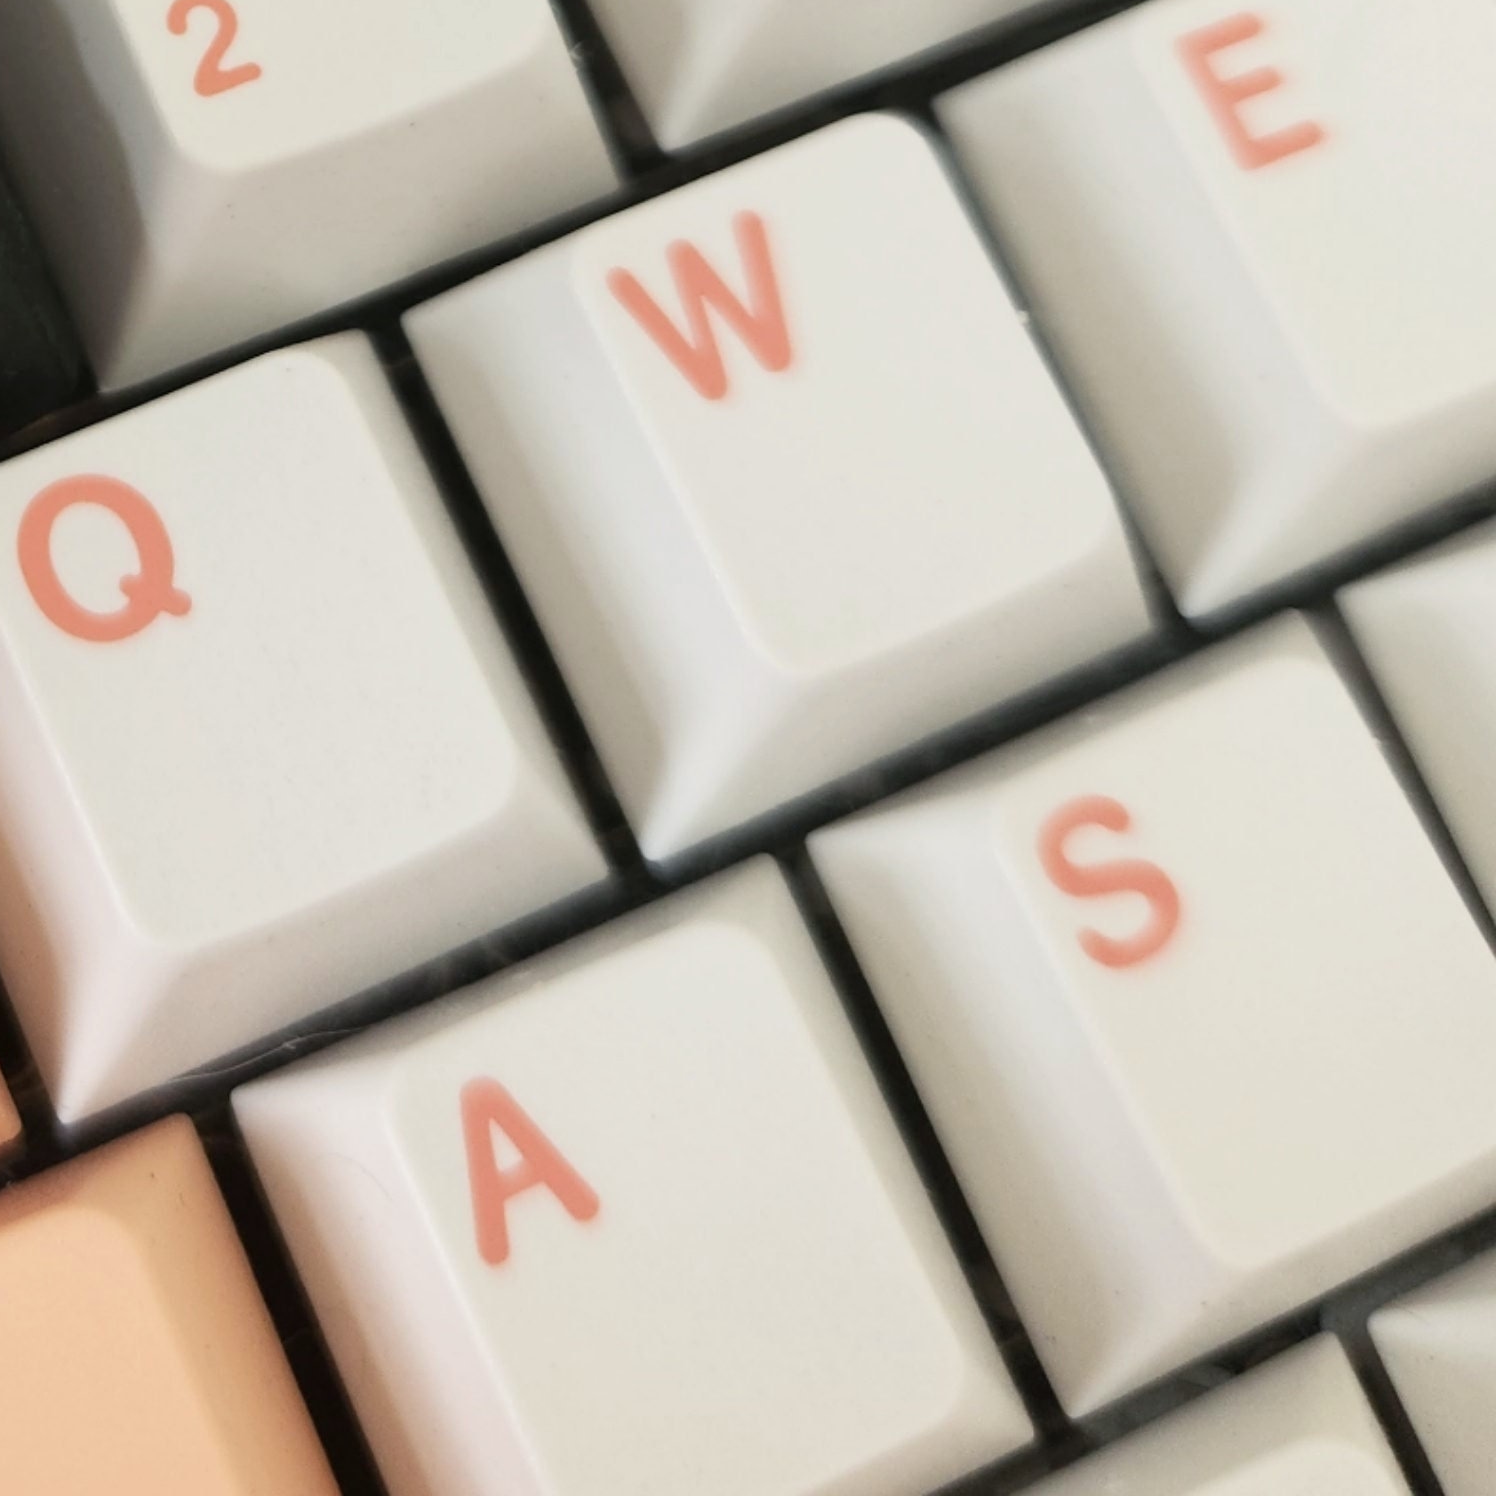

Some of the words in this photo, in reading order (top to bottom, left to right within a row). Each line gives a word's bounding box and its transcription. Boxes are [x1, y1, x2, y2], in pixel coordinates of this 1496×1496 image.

[1178, 13, 1326, 171] E
[608, 210, 796, 402] W
[17, 475, 191, 644] Q
[1039, 795, 1183, 971] S
[460, 1078, 600, 1267] A
